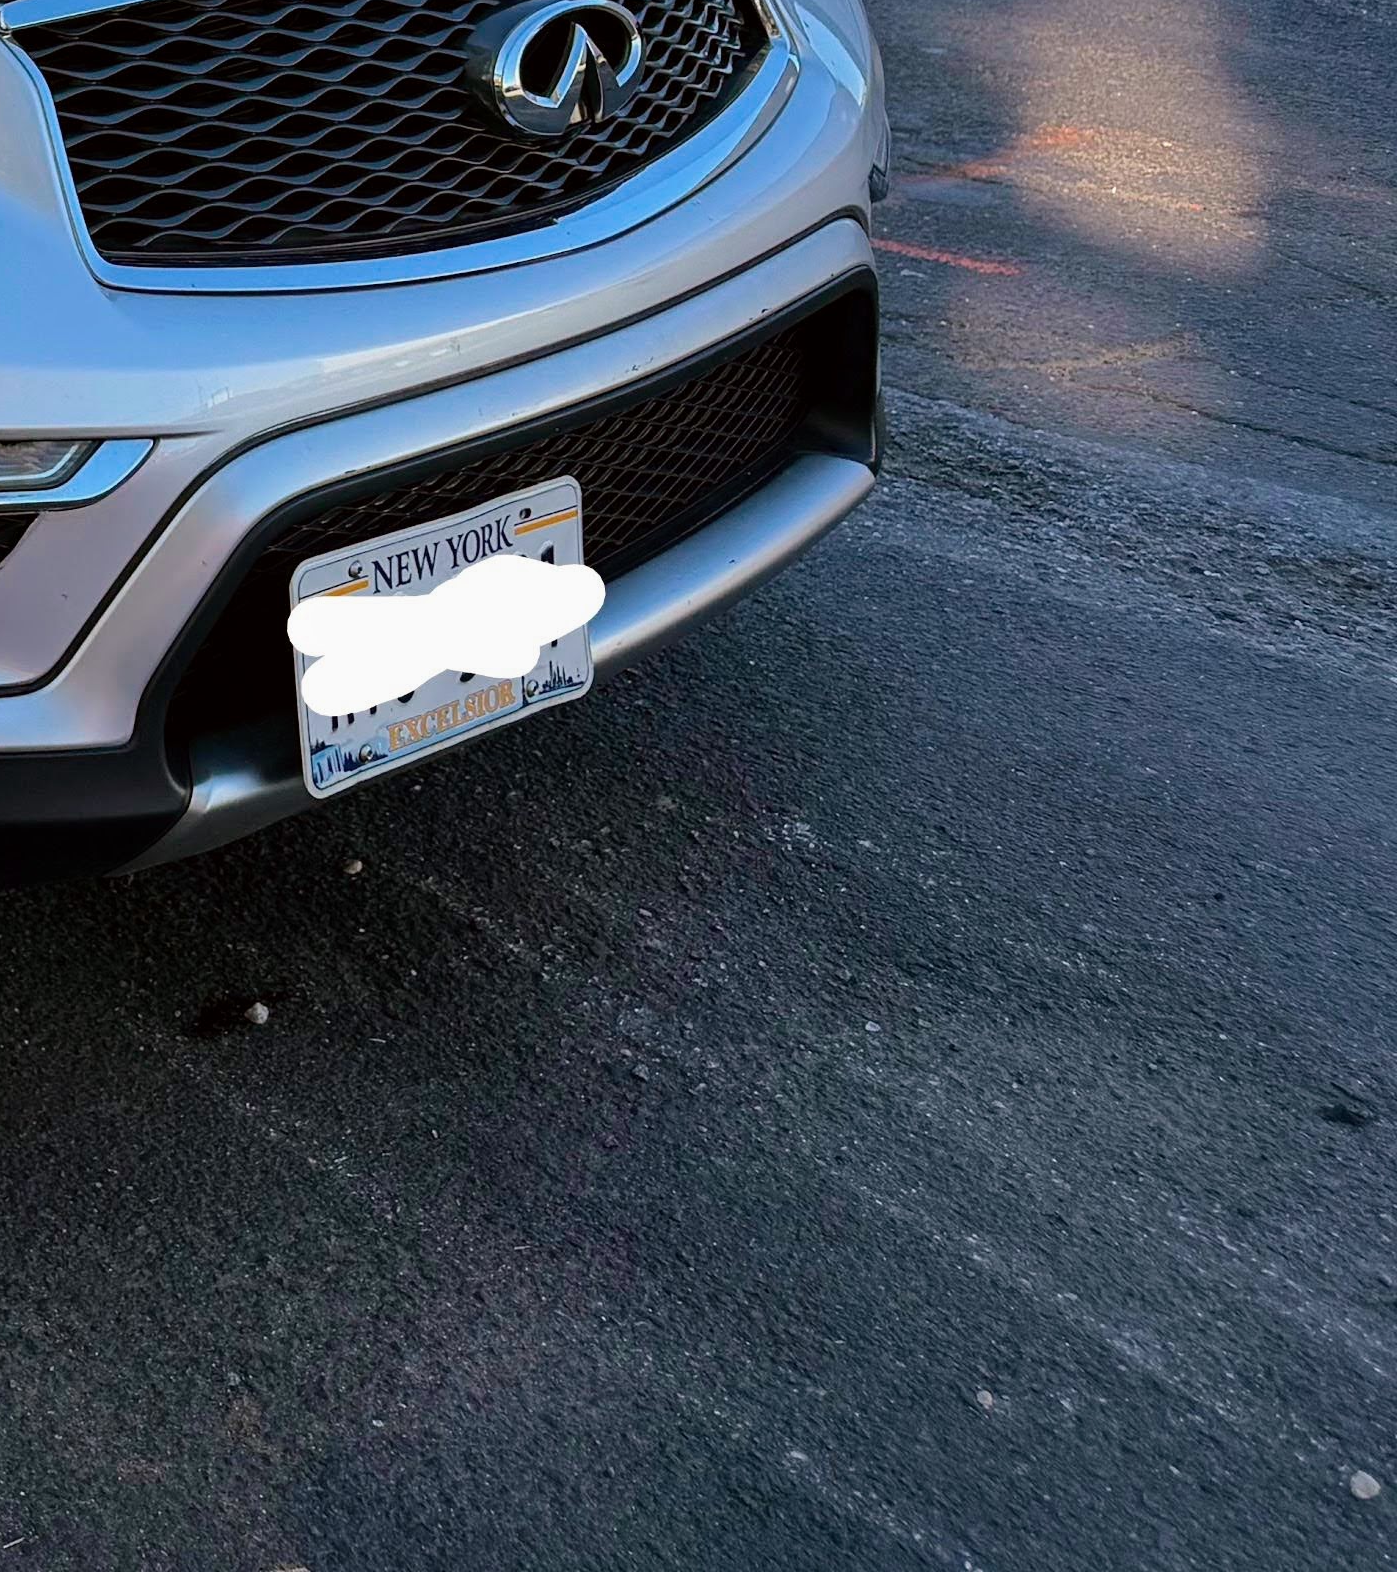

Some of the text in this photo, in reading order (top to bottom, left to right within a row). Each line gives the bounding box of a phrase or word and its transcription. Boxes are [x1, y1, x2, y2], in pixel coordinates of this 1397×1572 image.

[371, 514, 514, 595] NEW YORK
[386, 679, 516, 753] EXCELSIOR
